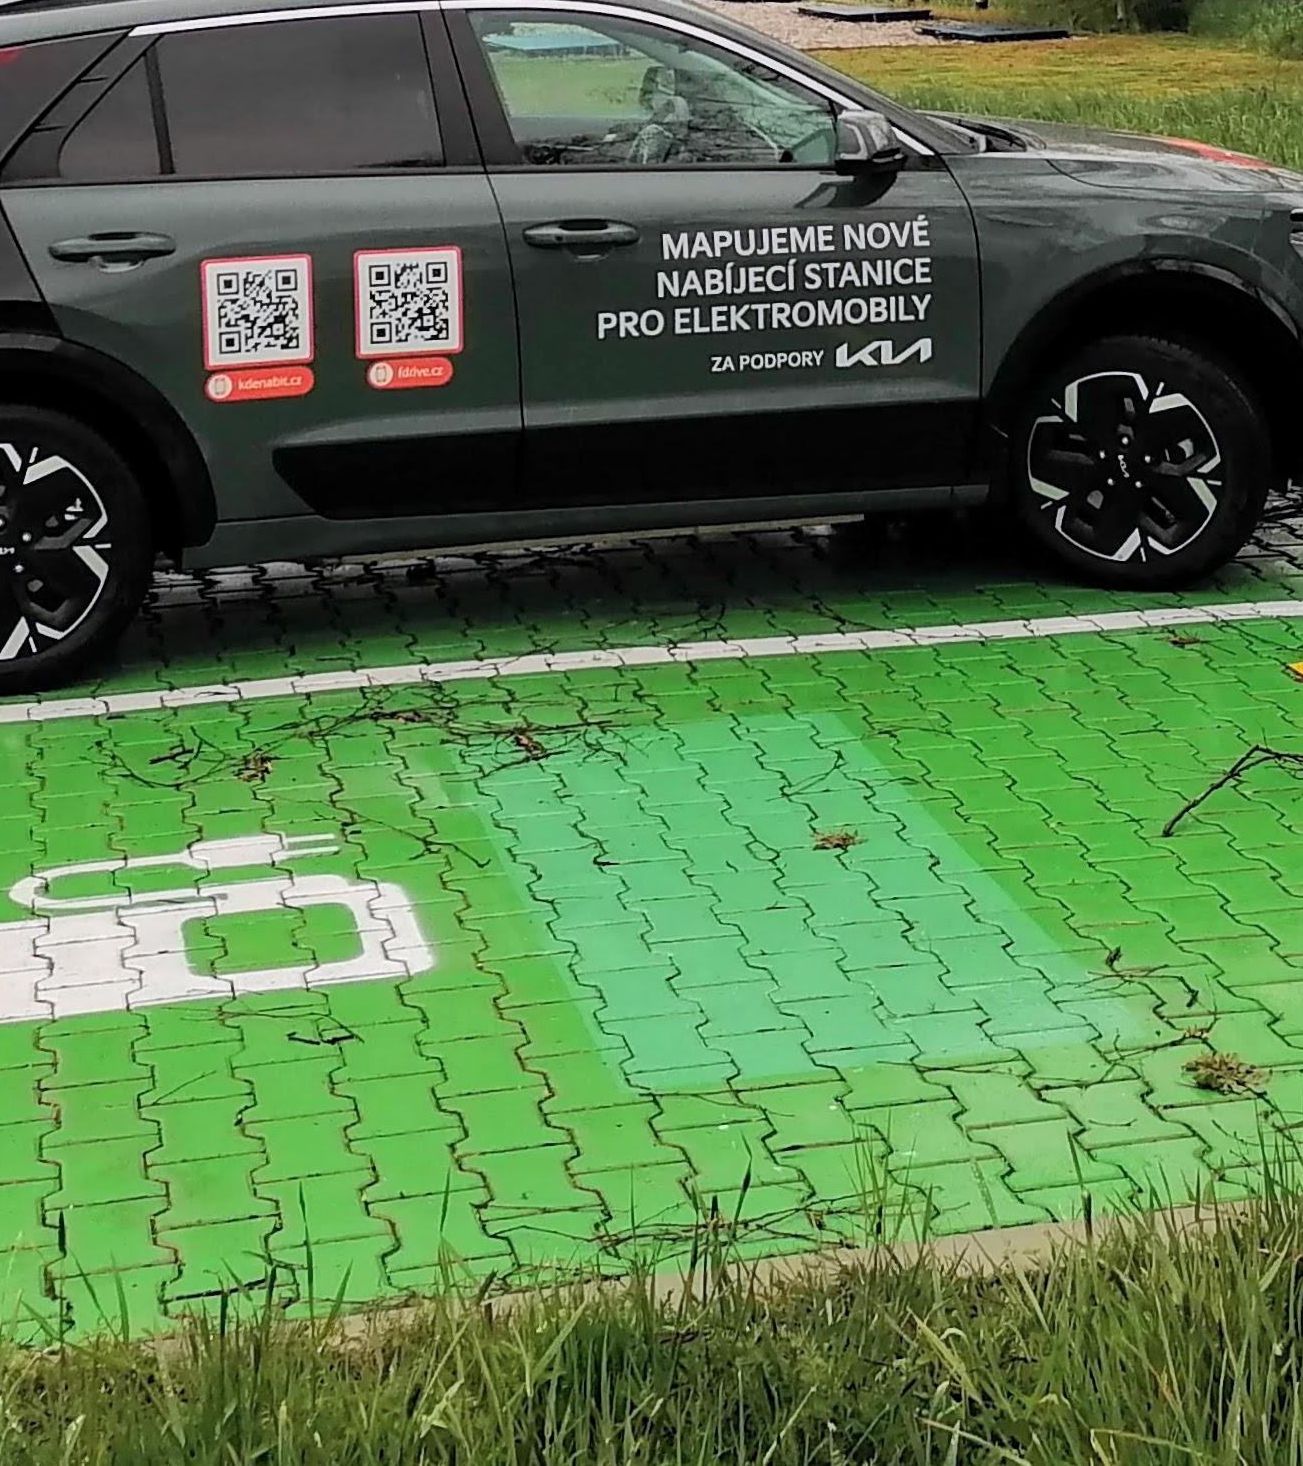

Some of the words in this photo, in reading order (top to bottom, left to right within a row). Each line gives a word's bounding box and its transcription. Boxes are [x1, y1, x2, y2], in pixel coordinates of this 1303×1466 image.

[661, 224, 835, 261] MAPUJEME
[843, 214, 931, 249] NOVÉ
[656, 258, 797, 298] NABÍJECÍ
[804, 257, 933, 290] STANICE
[596, 309, 665, 340] PRO
[674, 293, 933, 336] ELEKTROMOBILY
[710, 356, 735, 373] ZA
[739, 350, 825, 372] PODPORY
[237, 375, 304, 391] kdenabit.cz
